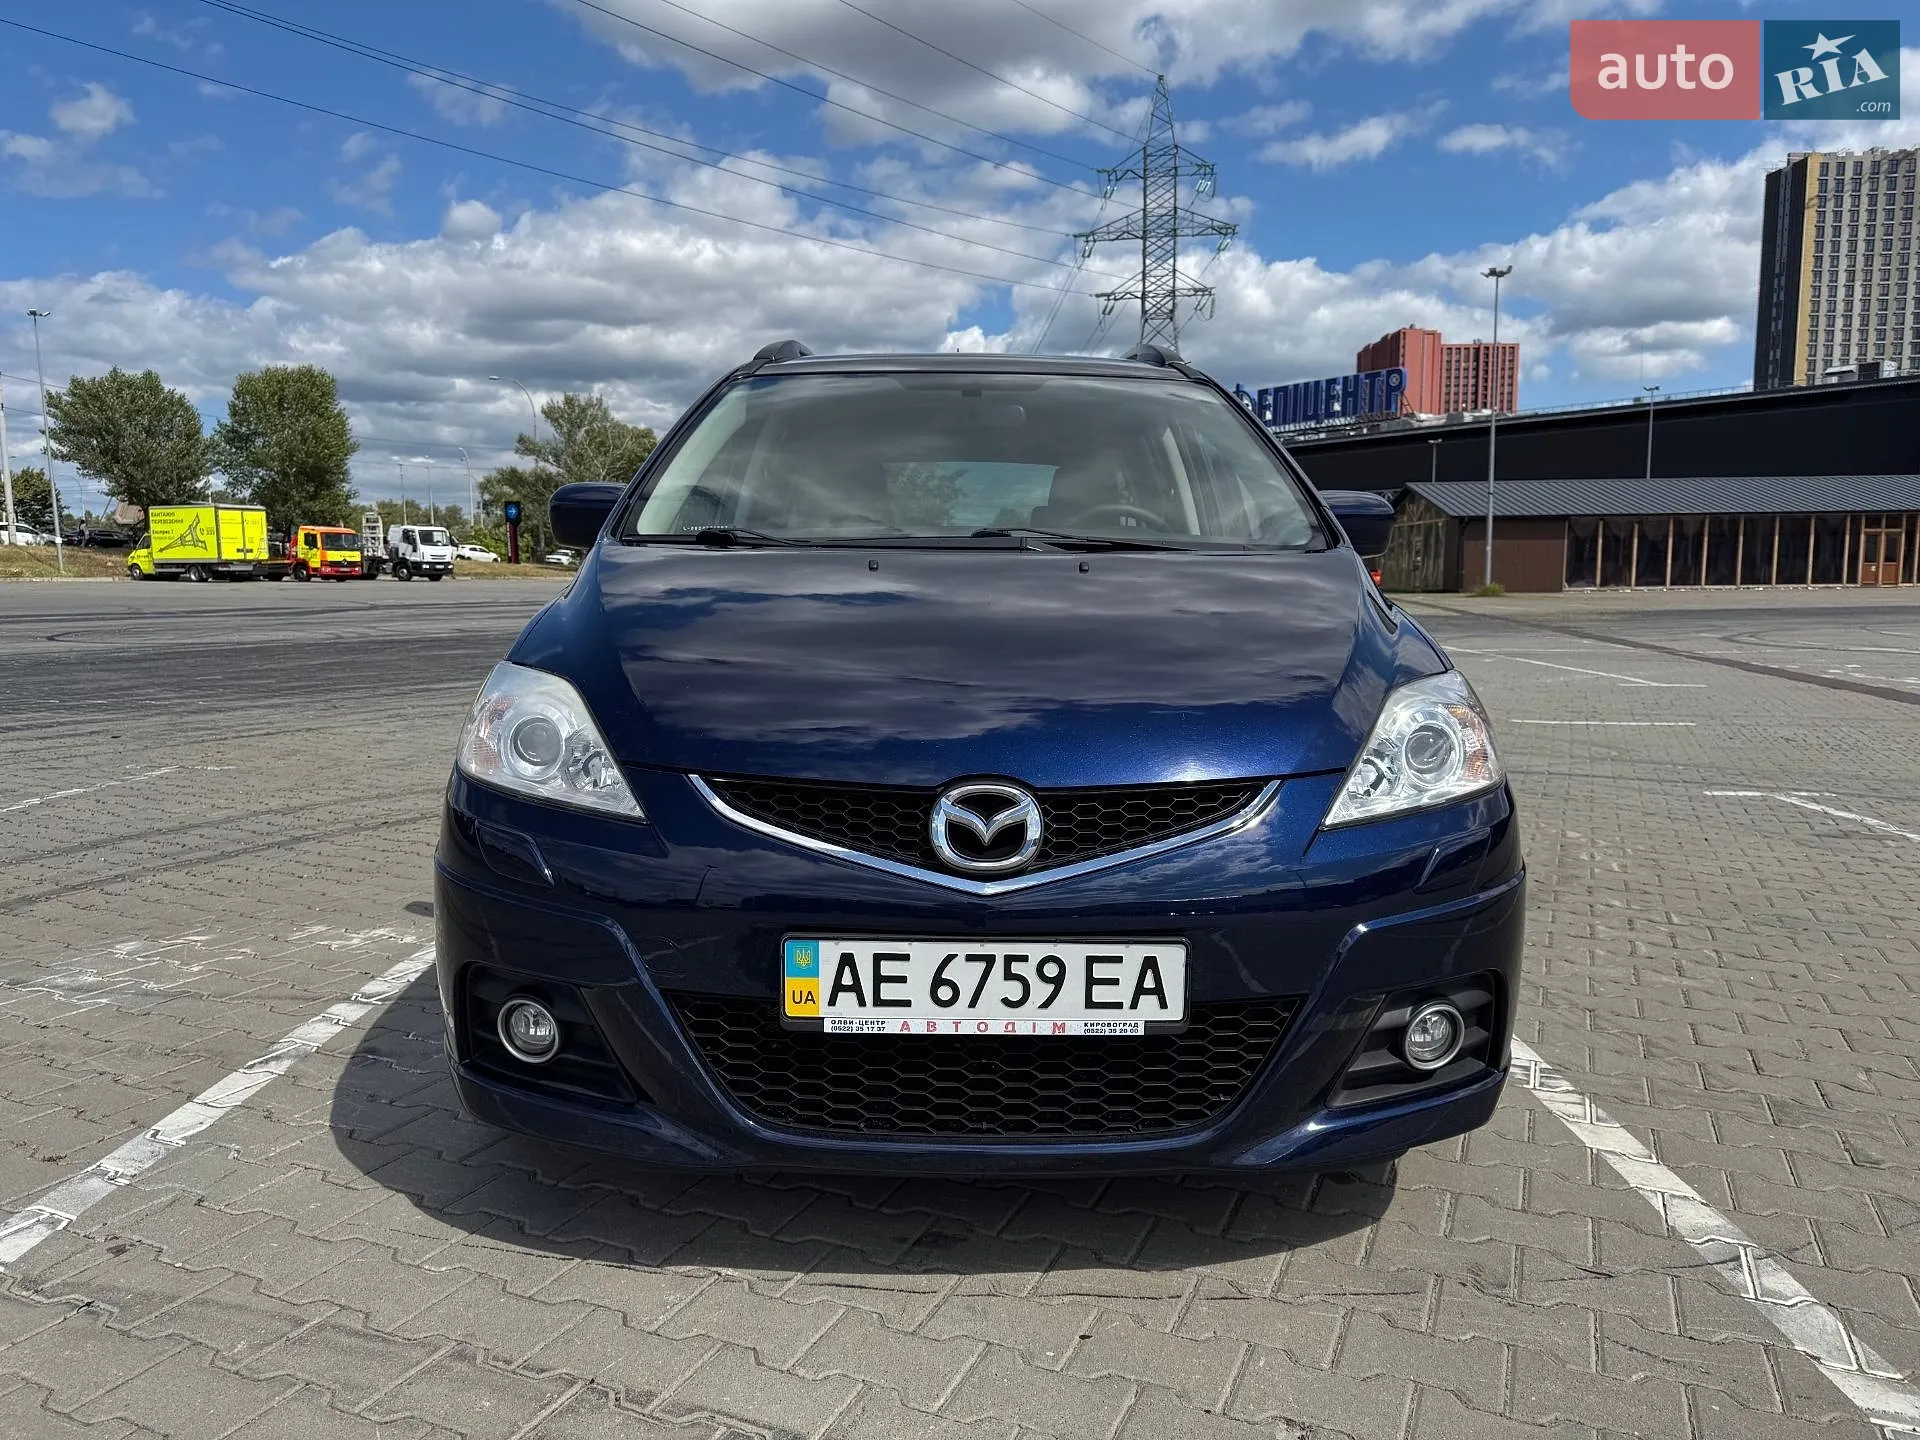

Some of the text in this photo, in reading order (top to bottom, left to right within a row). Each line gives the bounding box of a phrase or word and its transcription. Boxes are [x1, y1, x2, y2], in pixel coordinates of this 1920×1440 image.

[792, 990, 816, 1005] UA
[827, 952, 1169, 1009] AE 6759 EA
